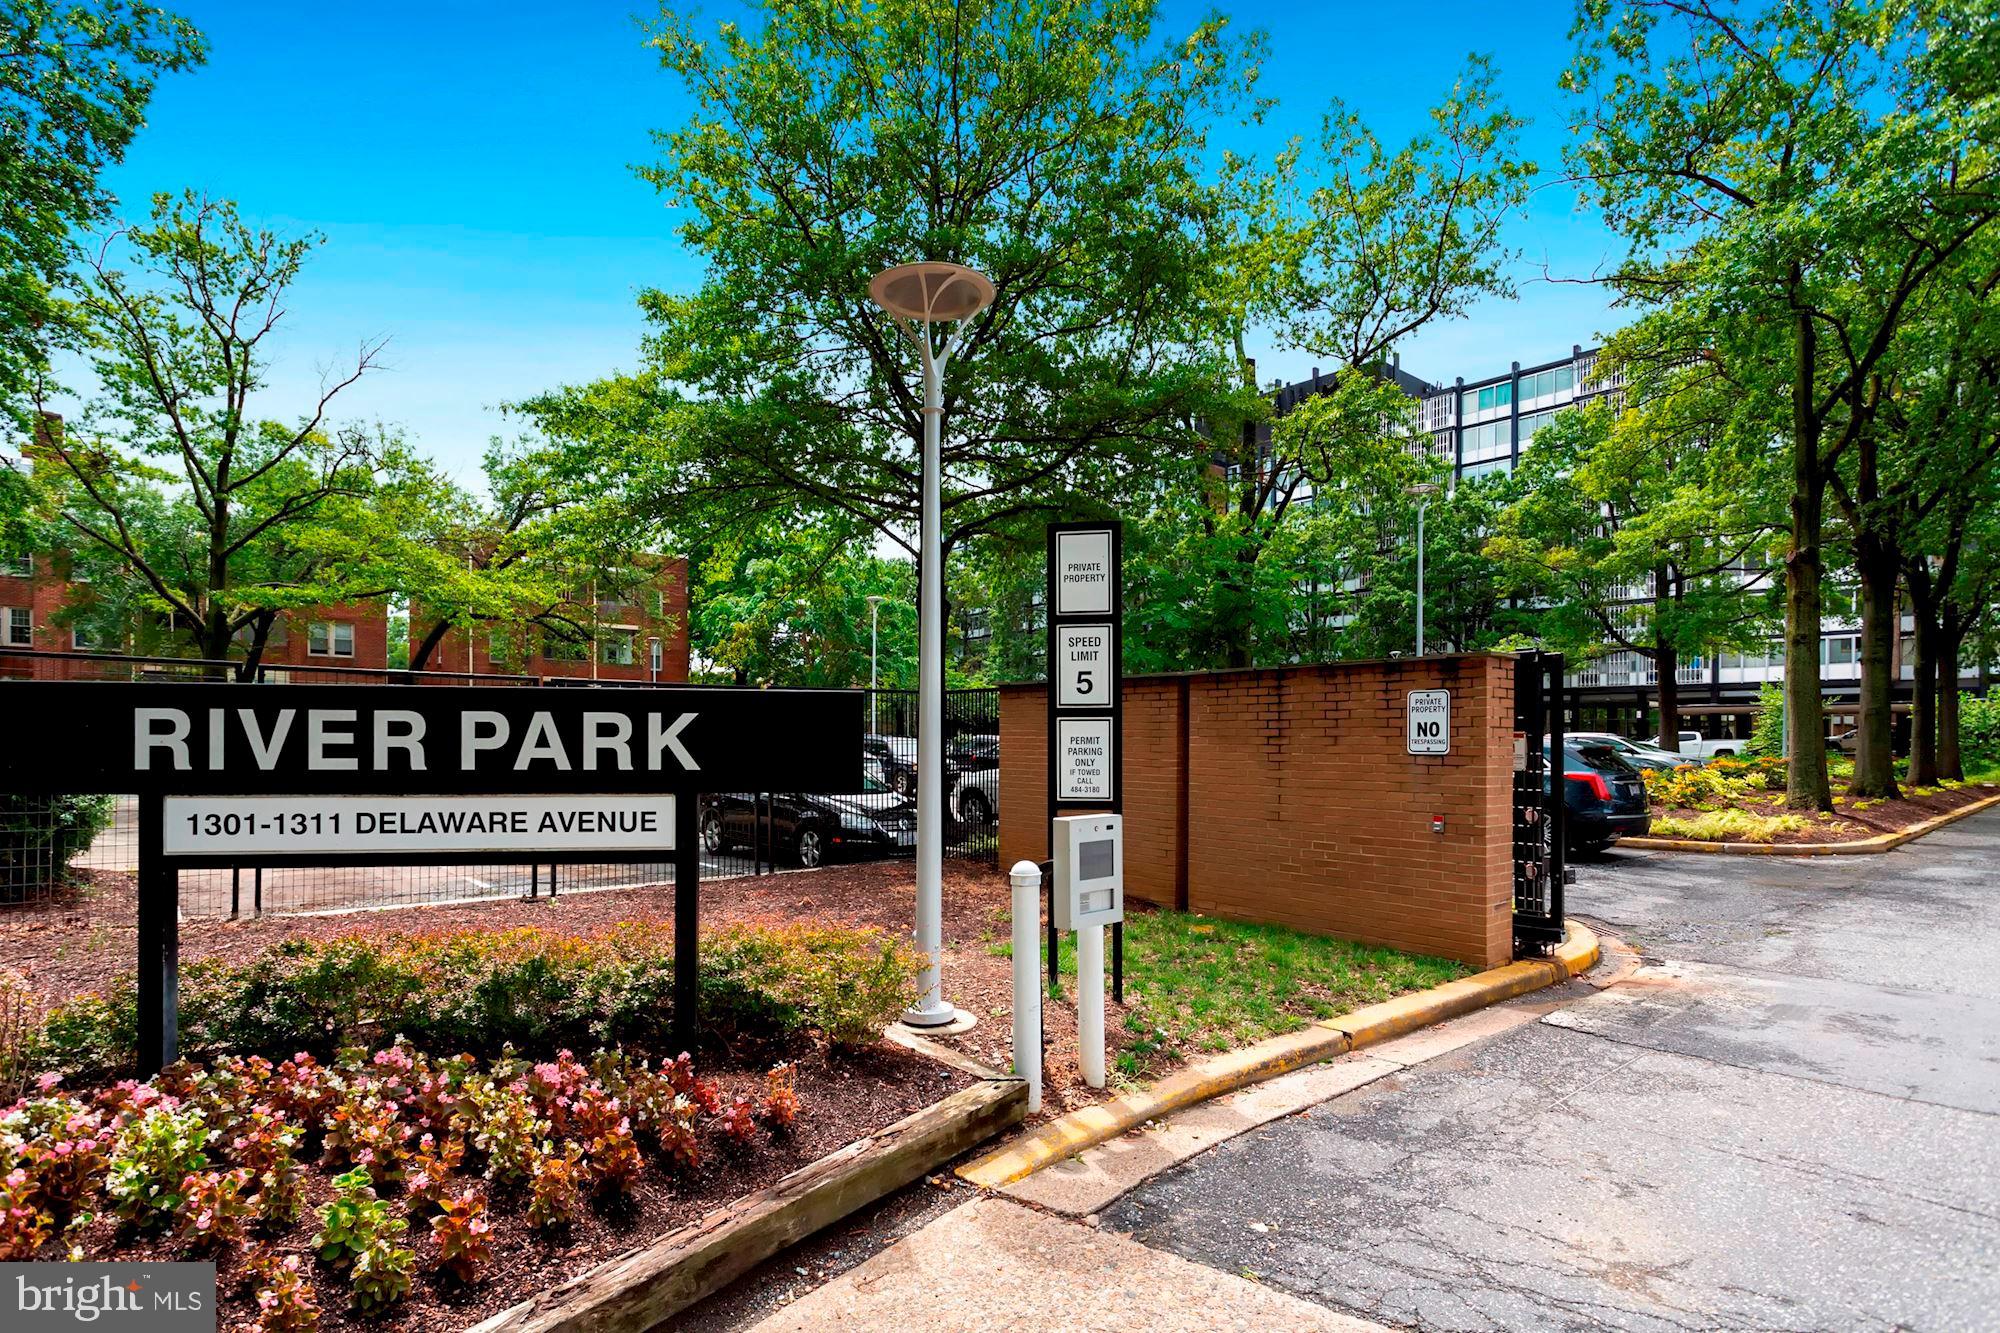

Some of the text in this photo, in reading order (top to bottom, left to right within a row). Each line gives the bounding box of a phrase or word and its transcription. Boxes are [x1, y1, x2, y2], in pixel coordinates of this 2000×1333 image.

[1068, 563, 1101, 572] PRIVATE
[1063, 573, 1106, 583] PROPERTY
[1068, 636, 1101, 648] SPEED
[1071, 651, 1099, 661] LIMIT
[1076, 671, 1093, 695] 5
[1417, 722, 1440, 737] NO
[134, 707, 701, 771] RIVER PARK
[1070, 736, 1101, 745] PERMIT
[1067, 747, 1103, 756] PARKING
[1075, 758, 1095, 767] ONLY
[1078, 768, 1101, 776] TOWED
[187, 811, 658, 836] 1301-1311 DELAWARE AVENUE
